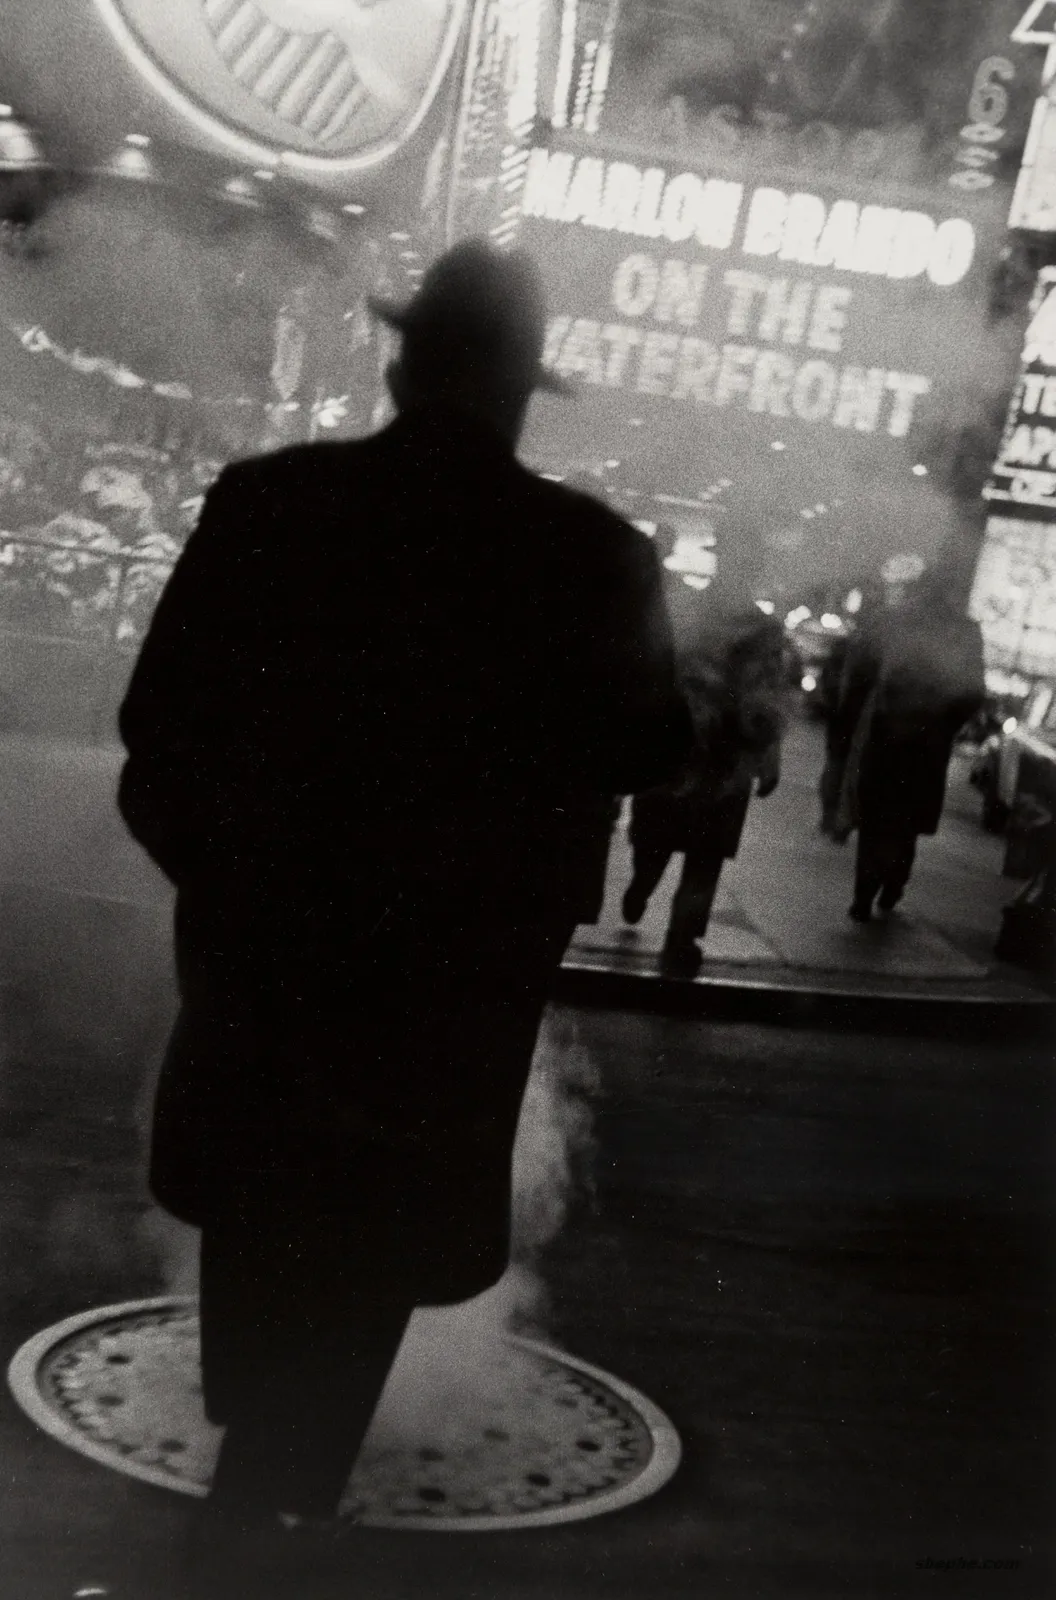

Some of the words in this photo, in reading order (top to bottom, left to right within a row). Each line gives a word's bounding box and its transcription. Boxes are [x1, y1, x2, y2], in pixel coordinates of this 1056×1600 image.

[521, 146, 745, 250] MARLON
[742, 186, 976, 287] BRANDO
[612, 252, 710, 327] ON
[723, 268, 853, 353] THE
